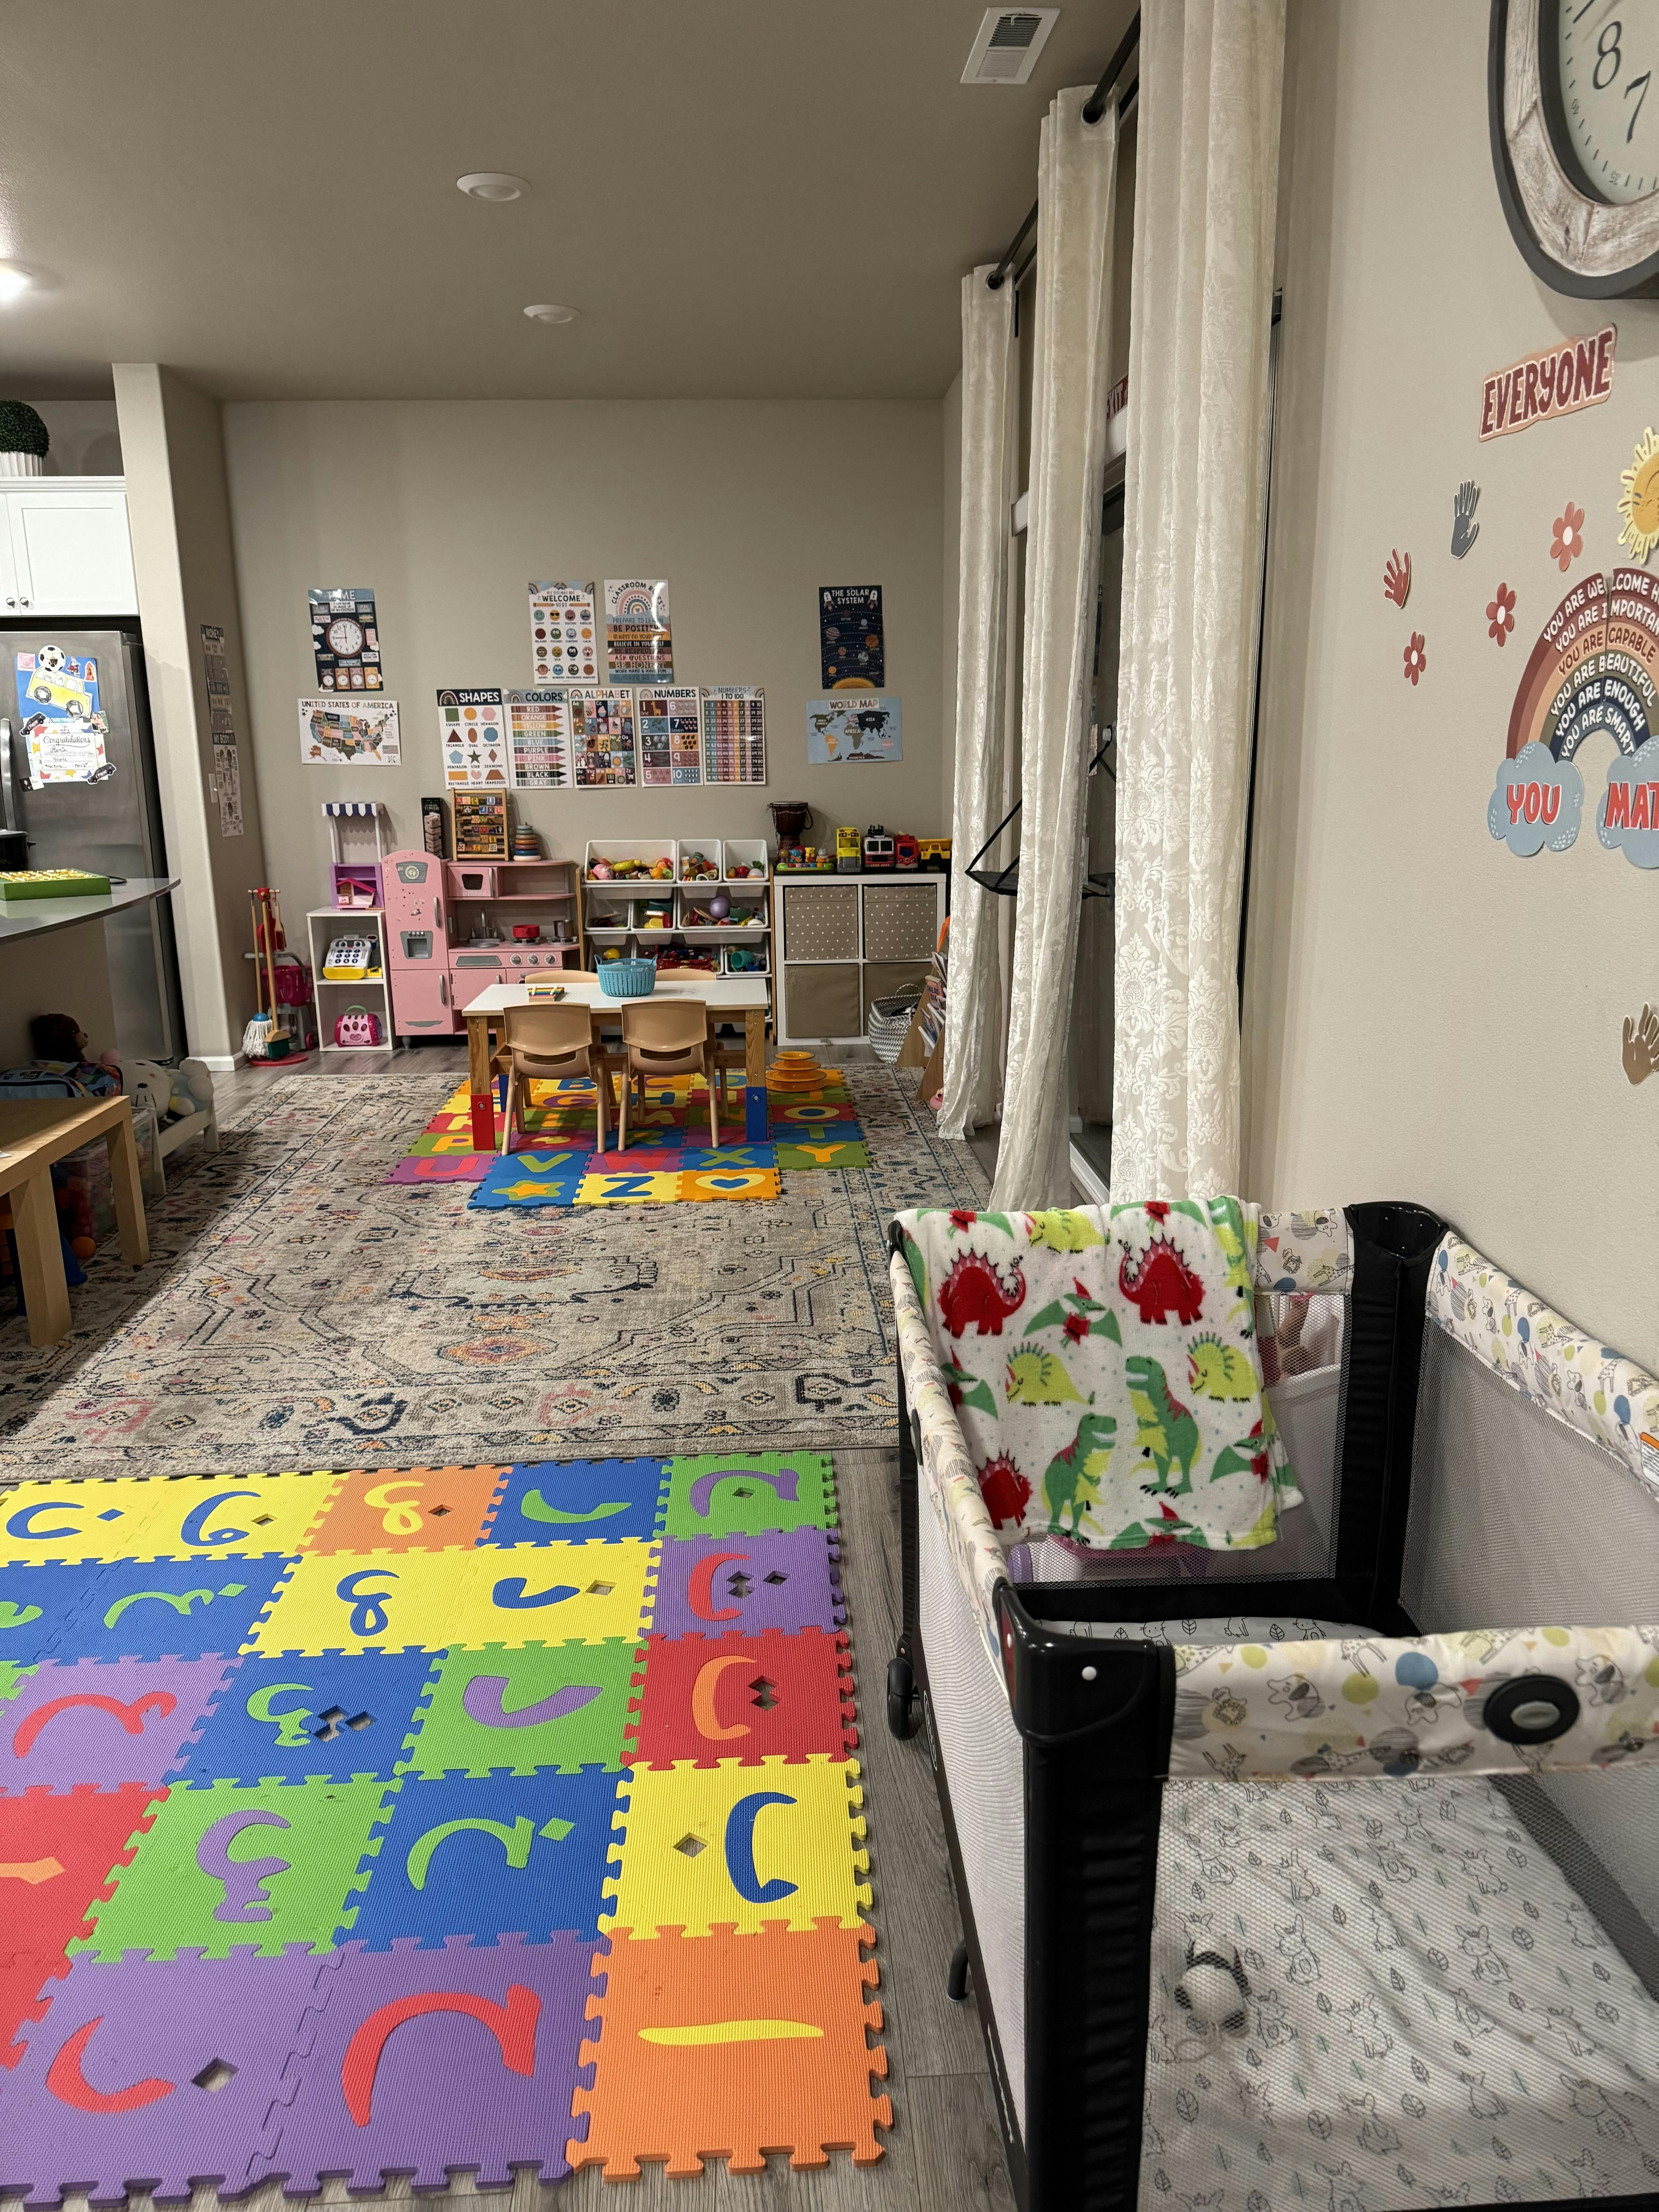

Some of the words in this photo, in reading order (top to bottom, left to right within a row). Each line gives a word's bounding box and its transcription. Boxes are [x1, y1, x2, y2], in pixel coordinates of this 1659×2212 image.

[1593, 21, 1621, 89] 8
[1624, 70, 1651, 143] 7
[1609, 171, 1621, 185] 35
[1481, 330, 1613, 436] EVERYONE
[327, 591, 356, 600] TME
[612, 582, 646, 604] CLASSROOM
[648, 586, 663, 605] RES
[1544, 611, 1563, 642] YOU
[1565, 589, 1585, 617] ARE
[1588, 573, 1650, 599] WELCOME
[1556, 623, 1575, 653] YOU
[1578, 606, 1598, 631] ARE
[1559, 647, 1579, 676] YOU
[1583, 631, 1602, 654] ARE
[1609, 627, 1656, 664] CAPABLE
[1551, 683, 1571, 716] YOU
[1574, 660, 1595, 688] ARE
[1599, 653, 1656, 707] BEAUTIFUL
[459, 692, 499, 703] SHAPES
[526, 692, 563, 701] COLORS
[585, 690, 630, 699] ALPHABET
[654, 690, 696, 698] NUMBERS
[643, 701, 646, 711] 1
[670, 701, 676, 710] 6
[830, 701, 857, 709] WORLD
[1556, 703, 1575, 736] YOU
[1578, 682, 1600, 708] ARE
[1604, 679, 1645, 731] ENOUGH
[642, 720, 648, 728] 2
[674, 719, 679, 728] 7
[1561, 725, 1579, 757] YOU
[1582, 706, 1603, 730] ARE
[1605, 708, 1634, 754] SMART
[43, 735, 91, 745] Congratulations
[645, 737, 651, 745] 3
[674, 735, 680, 744] 8
[644, 753, 651, 762] 4
[674, 752, 680, 761] 9
[645, 770, 651, 779] 5
[673, 769, 682, 779] 10
[1506, 781, 1561, 825] YOU
[543, 1094, 597, 1108] G
[541, 1113, 575, 1127] L
[794, 1124, 837, 1139] T
[431, 1135, 474, 1152] P
[604, 1151, 670, 1170] W
[699, 1147, 756, 1166] X
[796, 1144, 847, 1163] Y
[413, 1157, 479, 1177] U
[517, 1153, 573, 1173] V
[600, 1176, 655, 1198] Z
